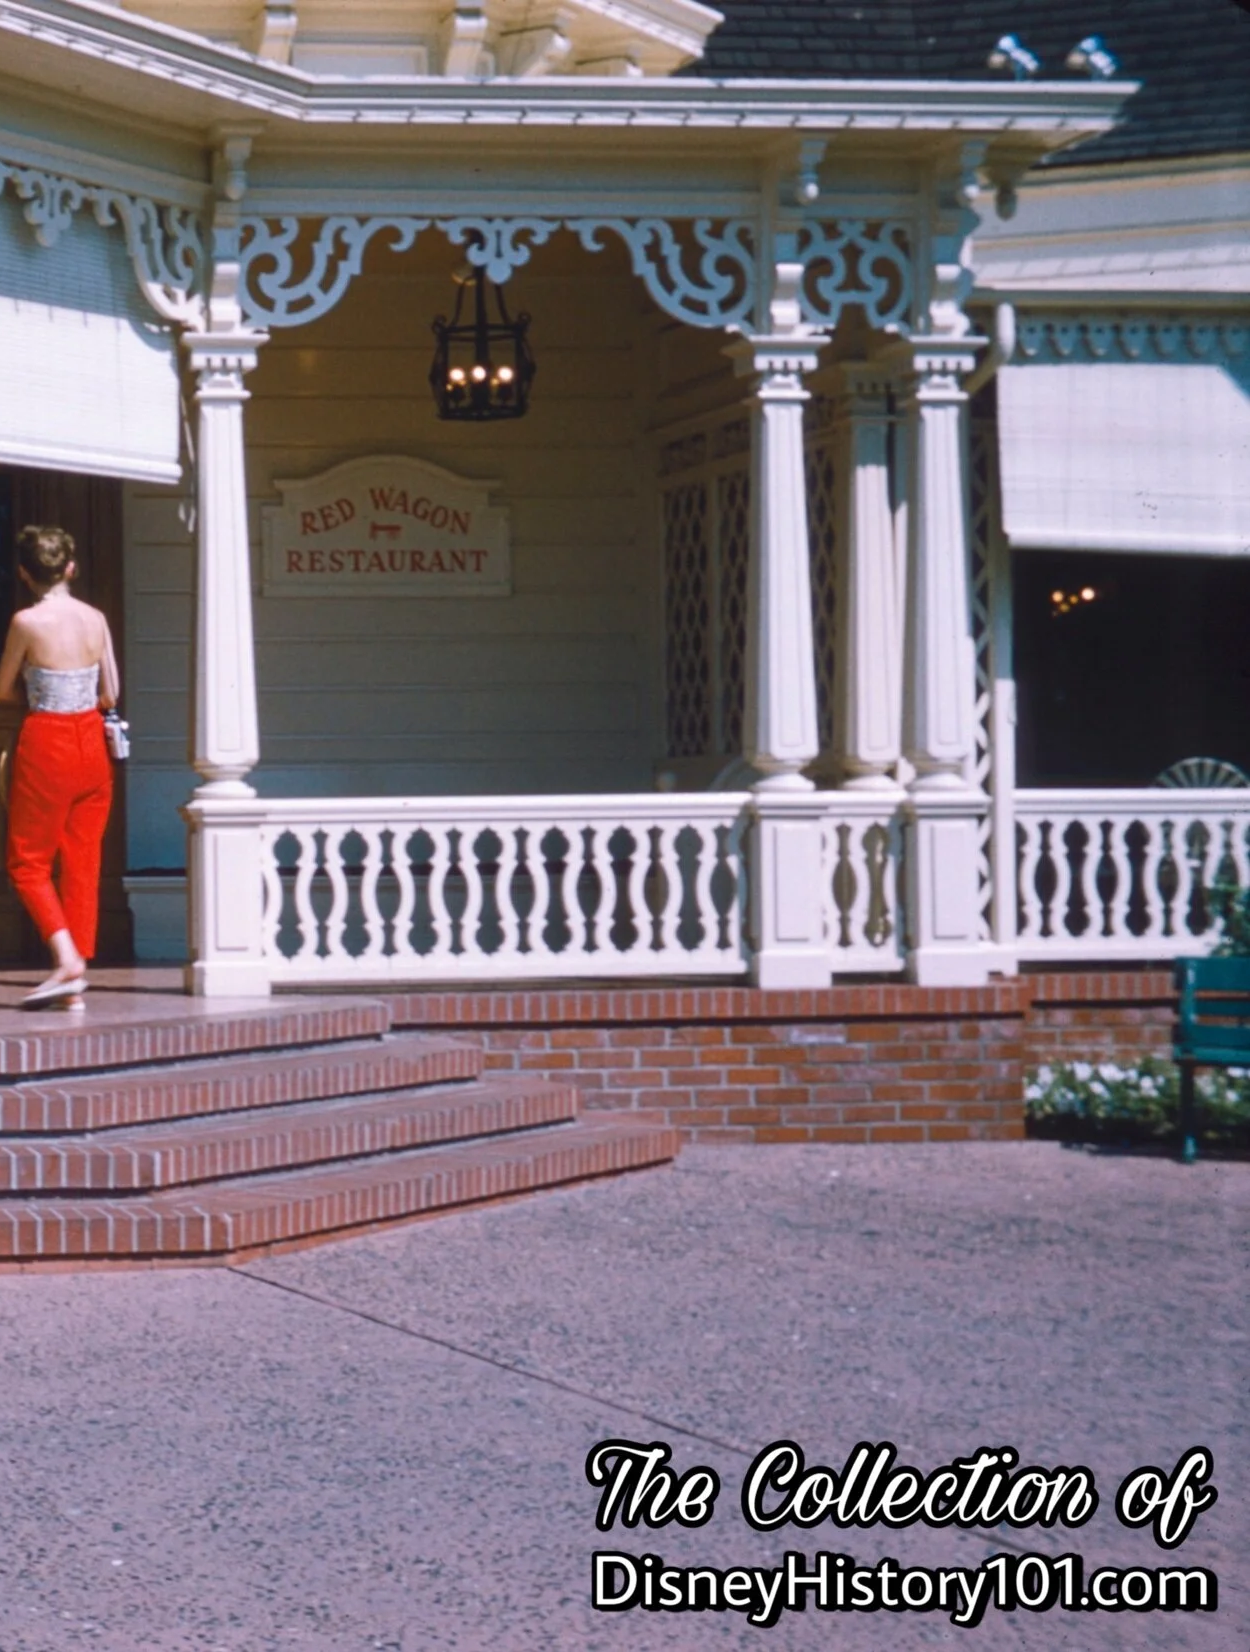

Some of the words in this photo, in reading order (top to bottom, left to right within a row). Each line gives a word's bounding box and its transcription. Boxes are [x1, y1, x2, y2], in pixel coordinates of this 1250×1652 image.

[300, 498, 356, 536] RED
[368, 486, 472, 535] WAGON
[285, 549, 489, 574] RESTAURANT
